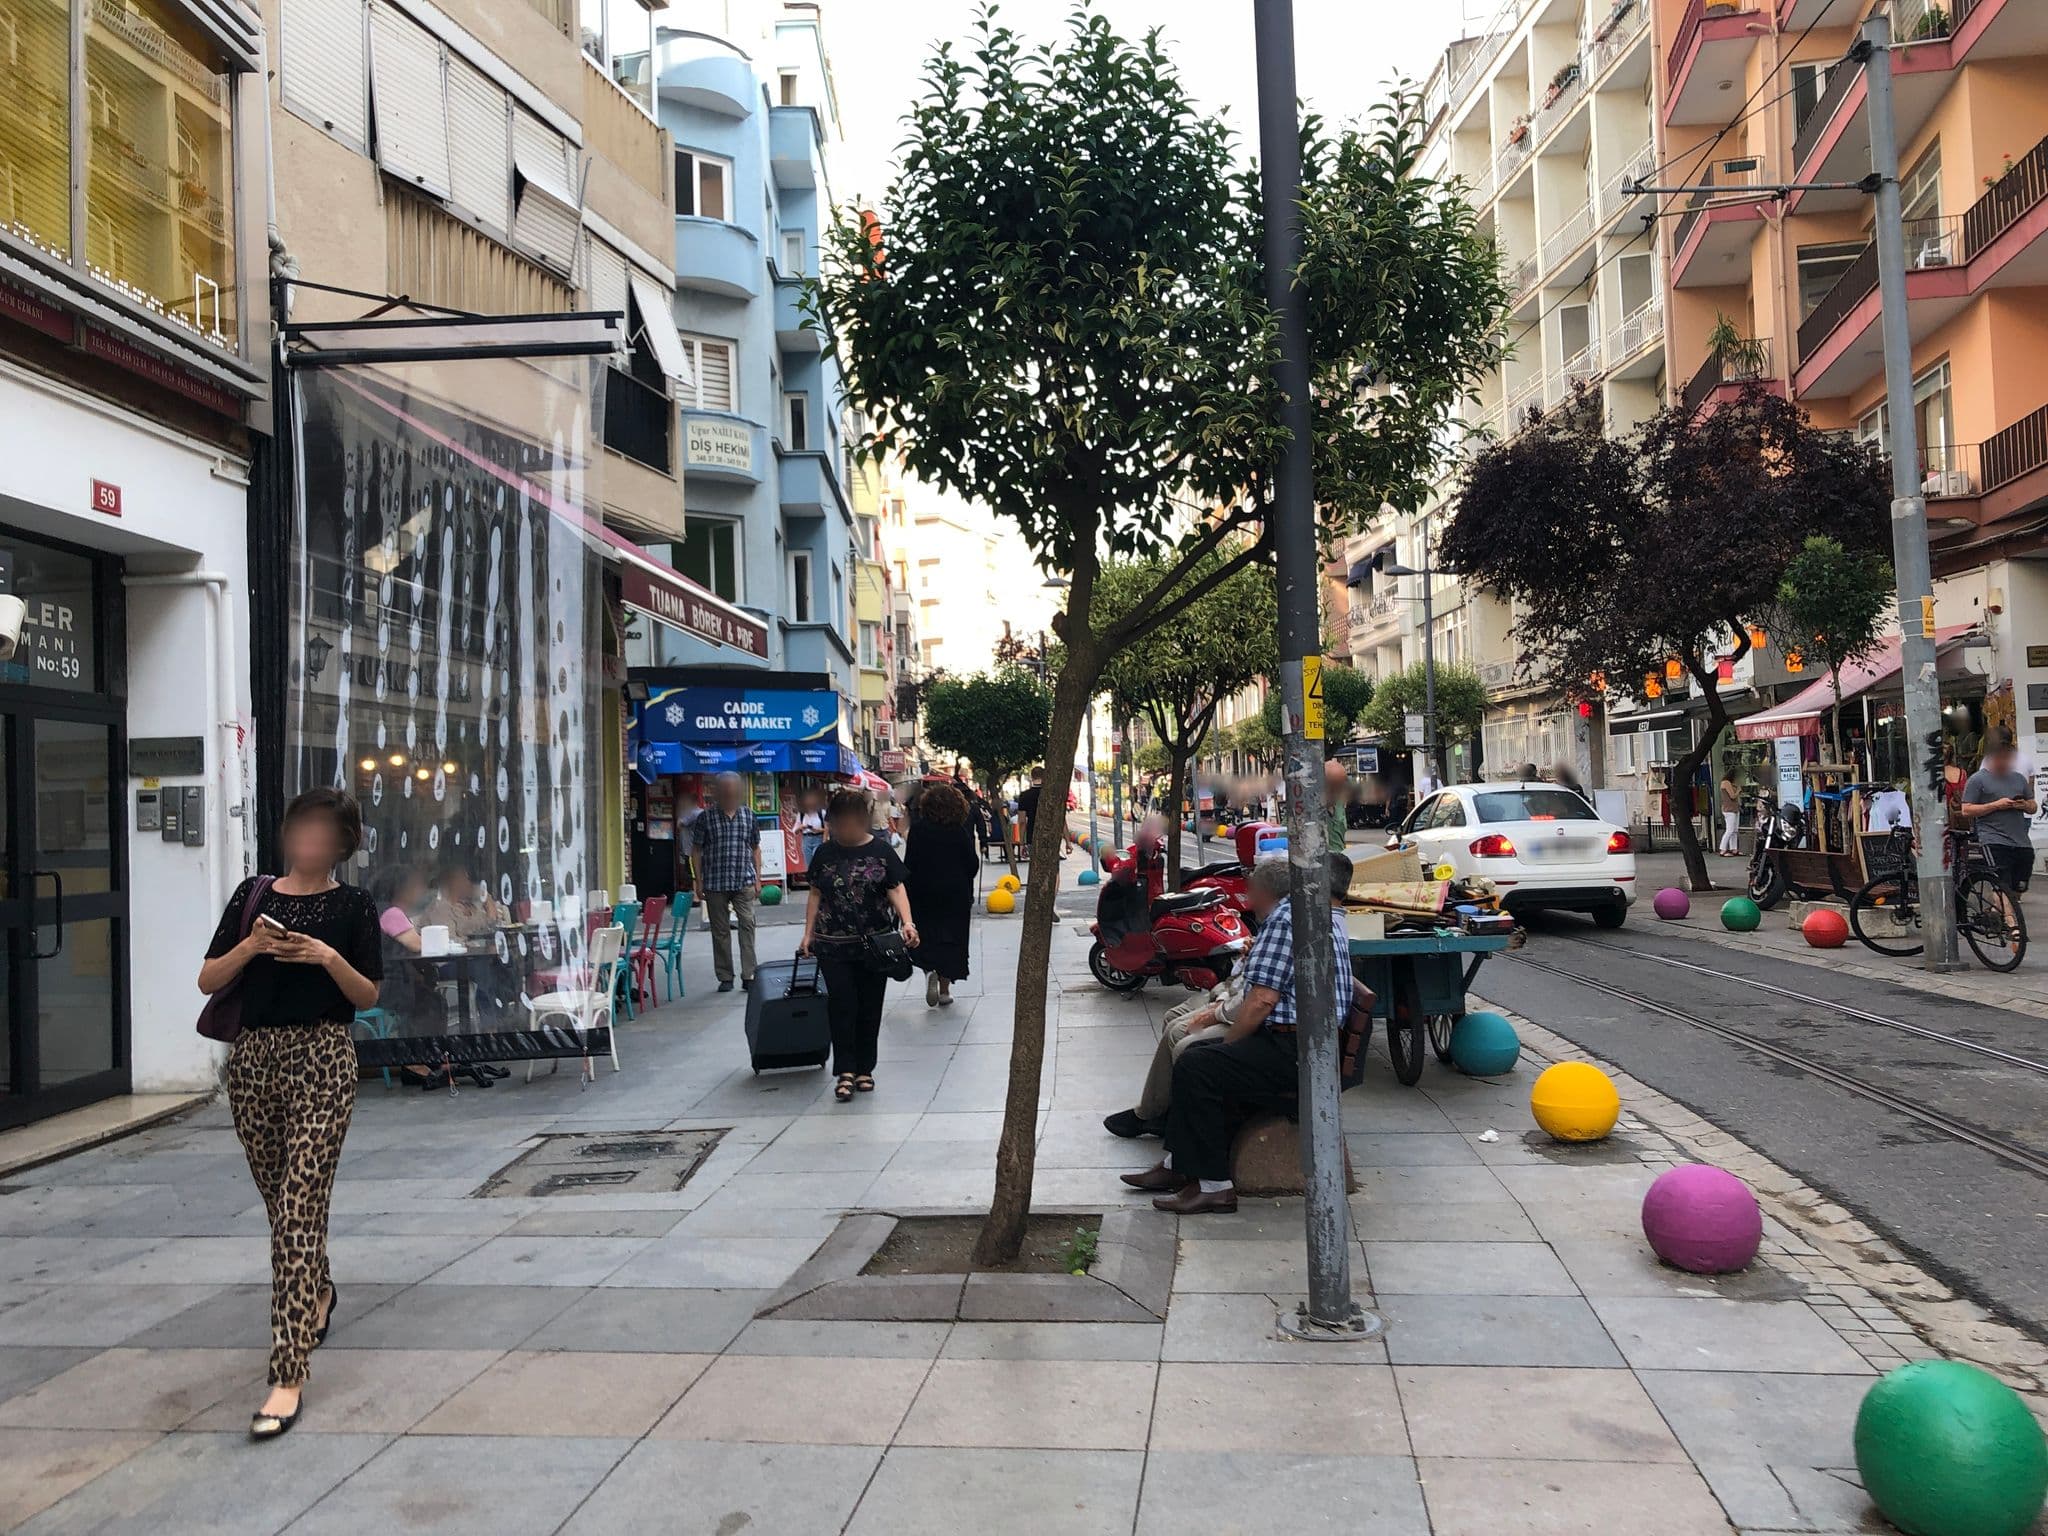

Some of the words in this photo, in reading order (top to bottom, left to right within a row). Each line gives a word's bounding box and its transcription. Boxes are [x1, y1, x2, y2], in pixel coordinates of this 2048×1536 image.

[691, 438, 712, 454] DİŞ
[100, 486, 116, 509] 59
[23, 599, 73, 632] LER
[649, 584, 686, 624] TUANA
[691, 604, 722, 639] BÖREK
[727, 621, 734, 642] &
[20, 631, 75, 654] MANI
[723, 701, 765, 715] CADDE
[696, 716, 726, 730] GIDA
[728, 717, 737, 729] &
[741, 717, 793, 730] MARKET
[879, 725, 888, 736] E
